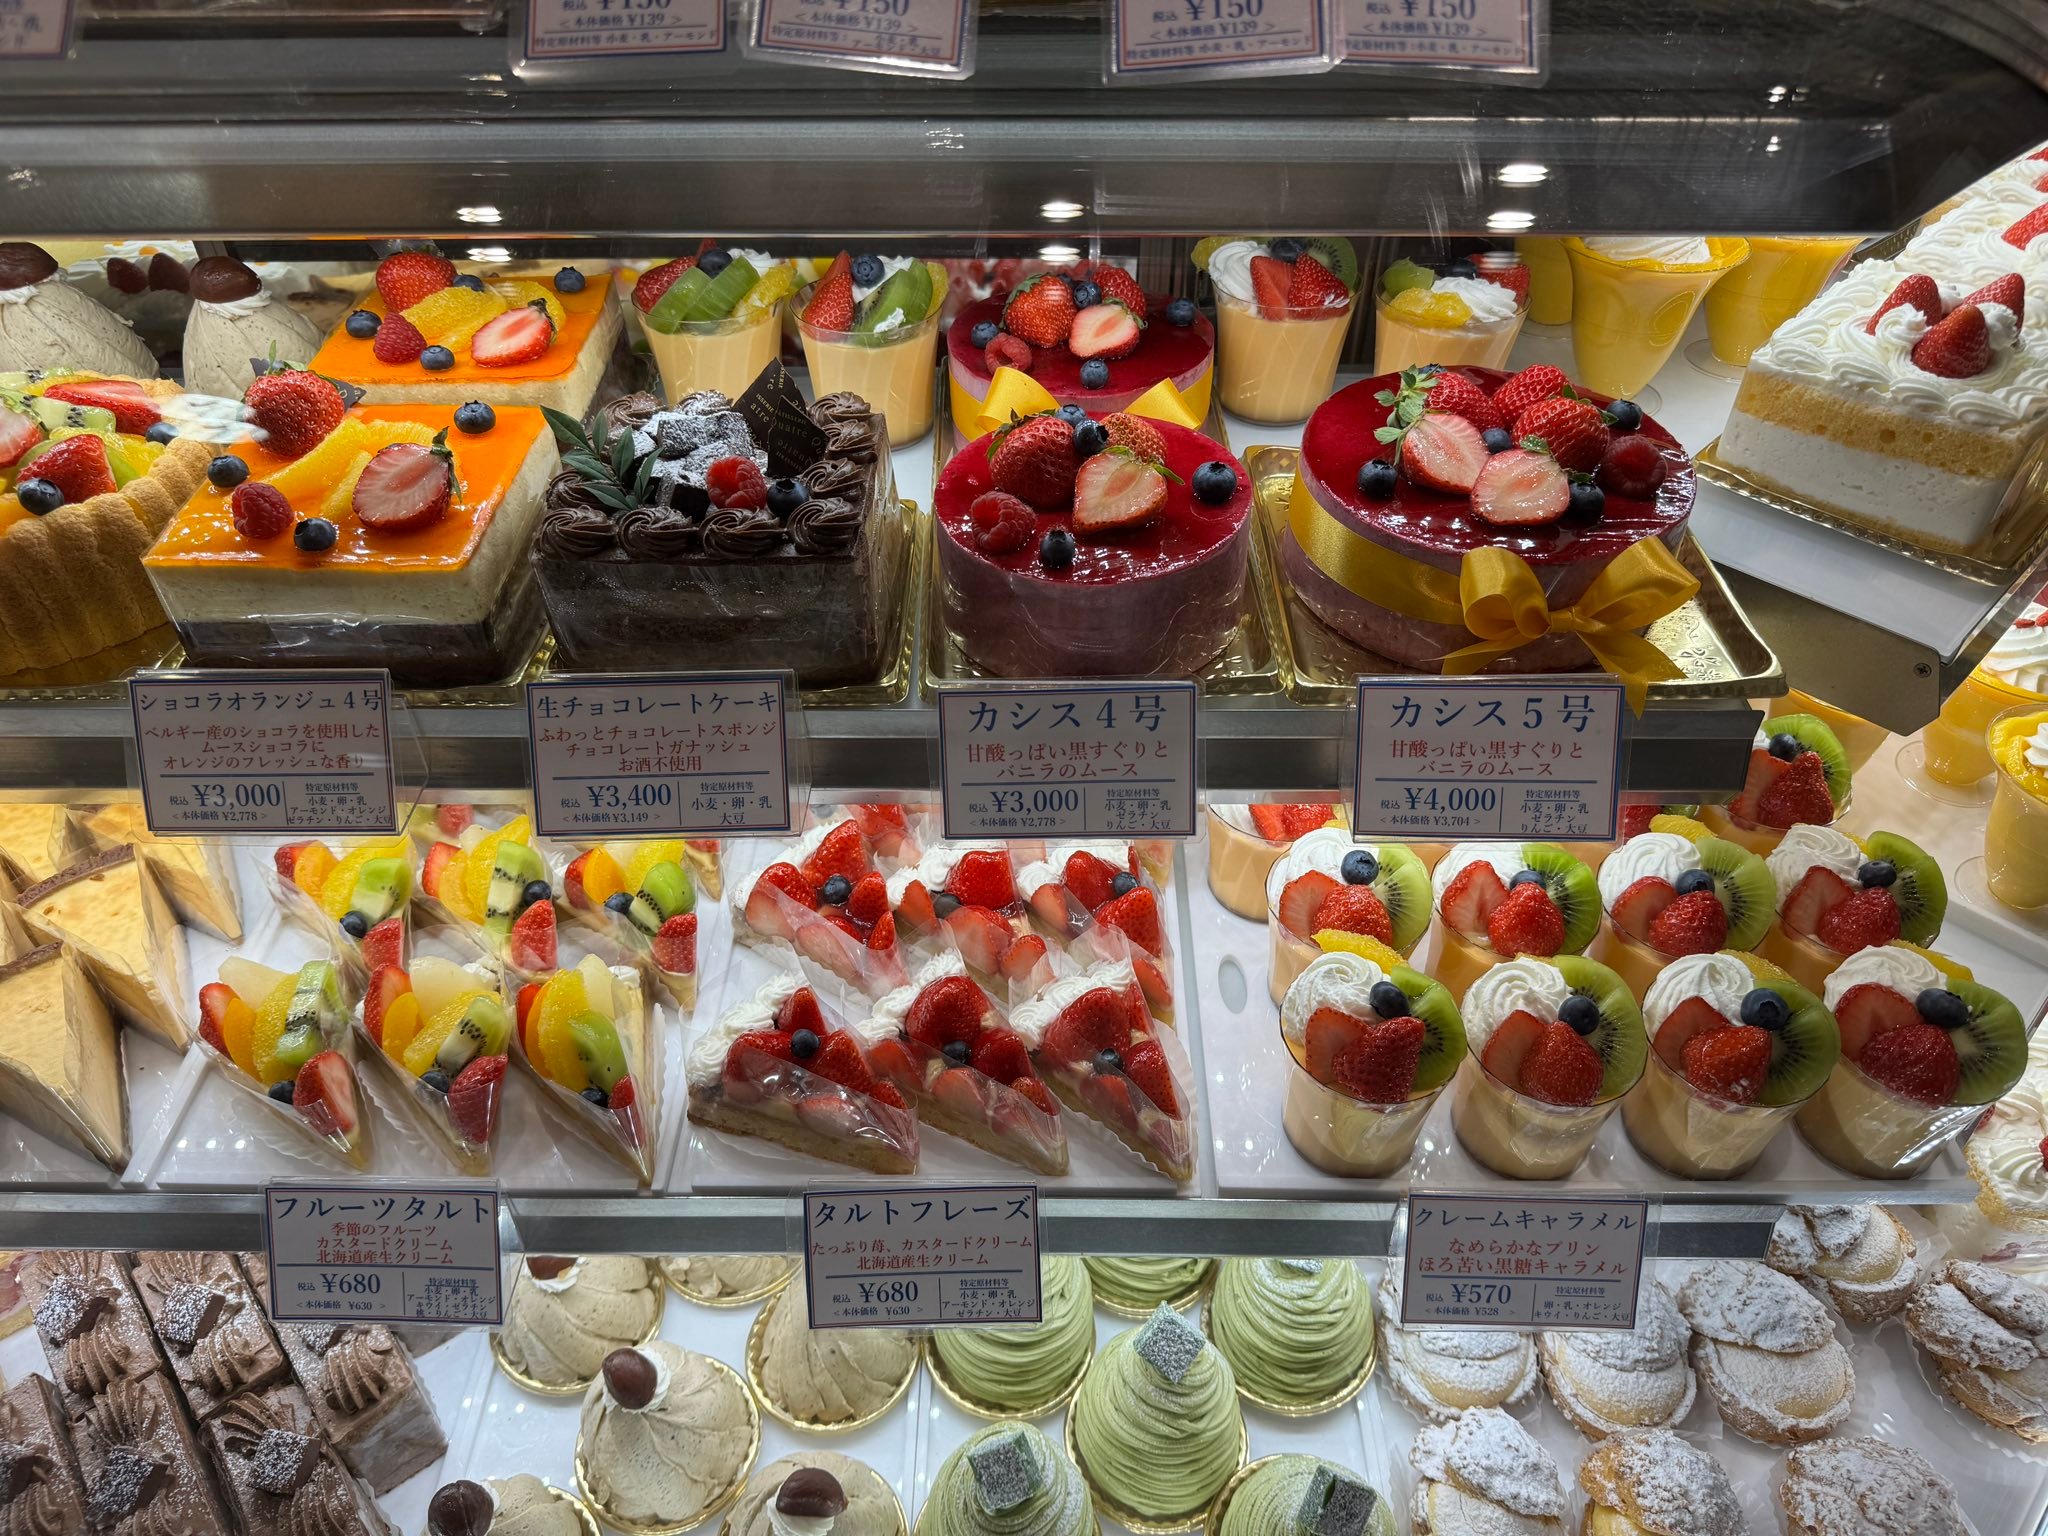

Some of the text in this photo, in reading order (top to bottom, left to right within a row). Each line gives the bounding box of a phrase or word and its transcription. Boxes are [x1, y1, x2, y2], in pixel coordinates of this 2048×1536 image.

[140, 689, 382, 712] ショコラオランジュ4号
[537, 691, 777, 719] 生チョコレートケーキ
[969, 694, 1167, 733] カシス4号
[1390, 694, 1595, 733] カシス5号
[144, 723, 380, 740] ベルギー産のショコラを使用した
[539, 722, 776, 742] ふわっとチョコレートスポンジ
[202, 740, 325, 753] ムースショコラに
[566, 740, 750, 758] チョコレートガナッシュ
[966, 741, 1168, 763] 甘酸っぱい黒すぐりと
[1390, 740, 1583, 759] 甘酸っぱい黒すぐりと
[163, 754, 365, 770] オレンジのフレッシュな香り
[618, 756, 702, 773] お酒不使用
[1419, 761, 1553, 777] バニラのムース
[997, 763, 1138, 780] バニラのムース
[192, 783, 281, 810] ¥3,000
[586, 784, 671, 809] ¥3,400
[990, 789, 1078, 816] ¥3,000
[1404, 788, 1495, 814] ¥4,000
[222, 811, 257, 821] ¥2,778
[612, 812, 648, 823] ¥3,149
[720, 813, 745, 825] 大豆
[1021, 817, 1056, 827] ¥2,778
[1116, 810, 1158, 820] ゼラチン
[1434, 816, 1470, 826] ¥3,704
[1531, 813, 1576, 823] ゼラチン
[275, 1196, 489, 1223] フルーツタルト
[815, 1195, 1032, 1228] タルトフレーズ
[1415, 1208, 1637, 1231] クレームキャラメル
[331, 1222, 437, 1237] 季節のフルーツ
[316, 1237, 453, 1251] カスタードクリーム
[812, 1236, 1032, 1256] たっぷり苺、カスタードクリーム
[1449, 1238, 1600, 1256] なめらかなプリン
[316, 1250, 454, 1264] 北海道産生クリーム
[857, 1254, 989, 1271] 北海道産生クリーム
[1418, 1257, 1629, 1275] ほろ苦い黒糖キャラメル
[320, 1273, 381, 1294] ¥680
[857, 1280, 918, 1303] ¥680
[1451, 1283, 1511, 1305] ¥570
[349, 1301, 372, 1311] ¥630
[886, 1306, 910, 1316] ¥630
[1475, 1307, 1499, 1316] ¥528
